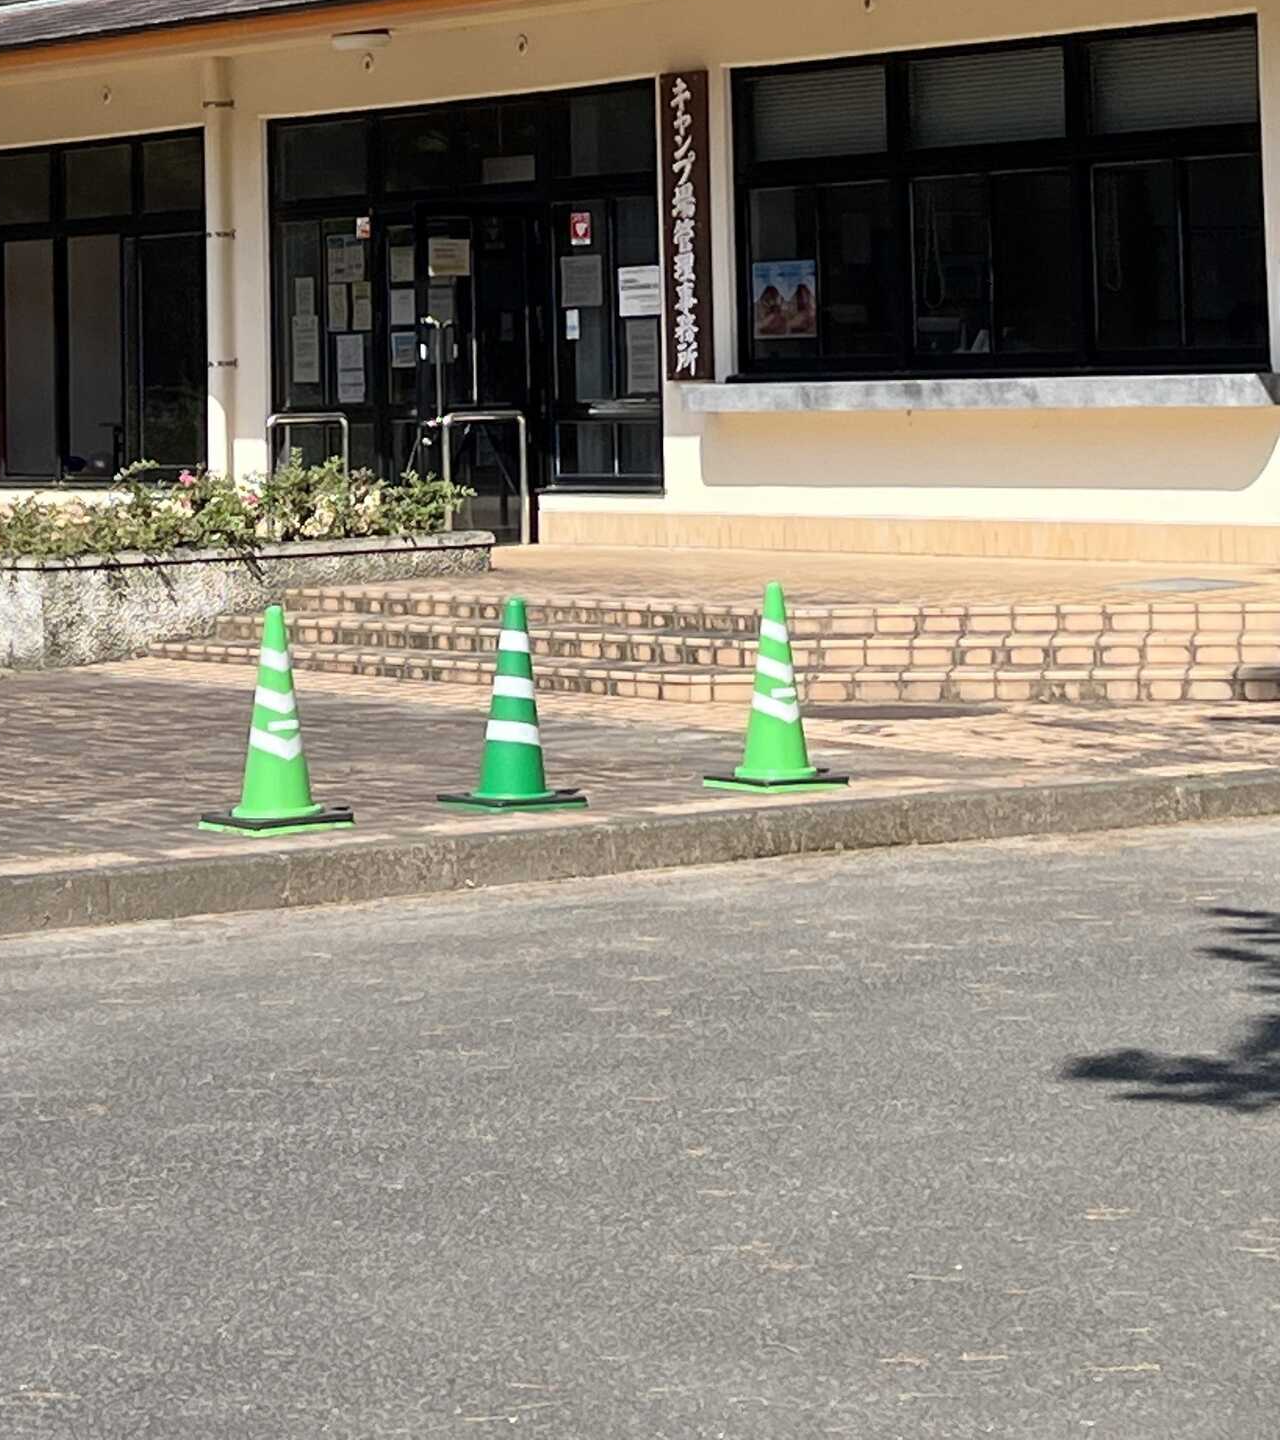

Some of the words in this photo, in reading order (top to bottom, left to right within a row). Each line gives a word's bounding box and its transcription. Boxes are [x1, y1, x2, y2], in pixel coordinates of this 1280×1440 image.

[670, 77, 700, 377] キャンプ場管理事務所
